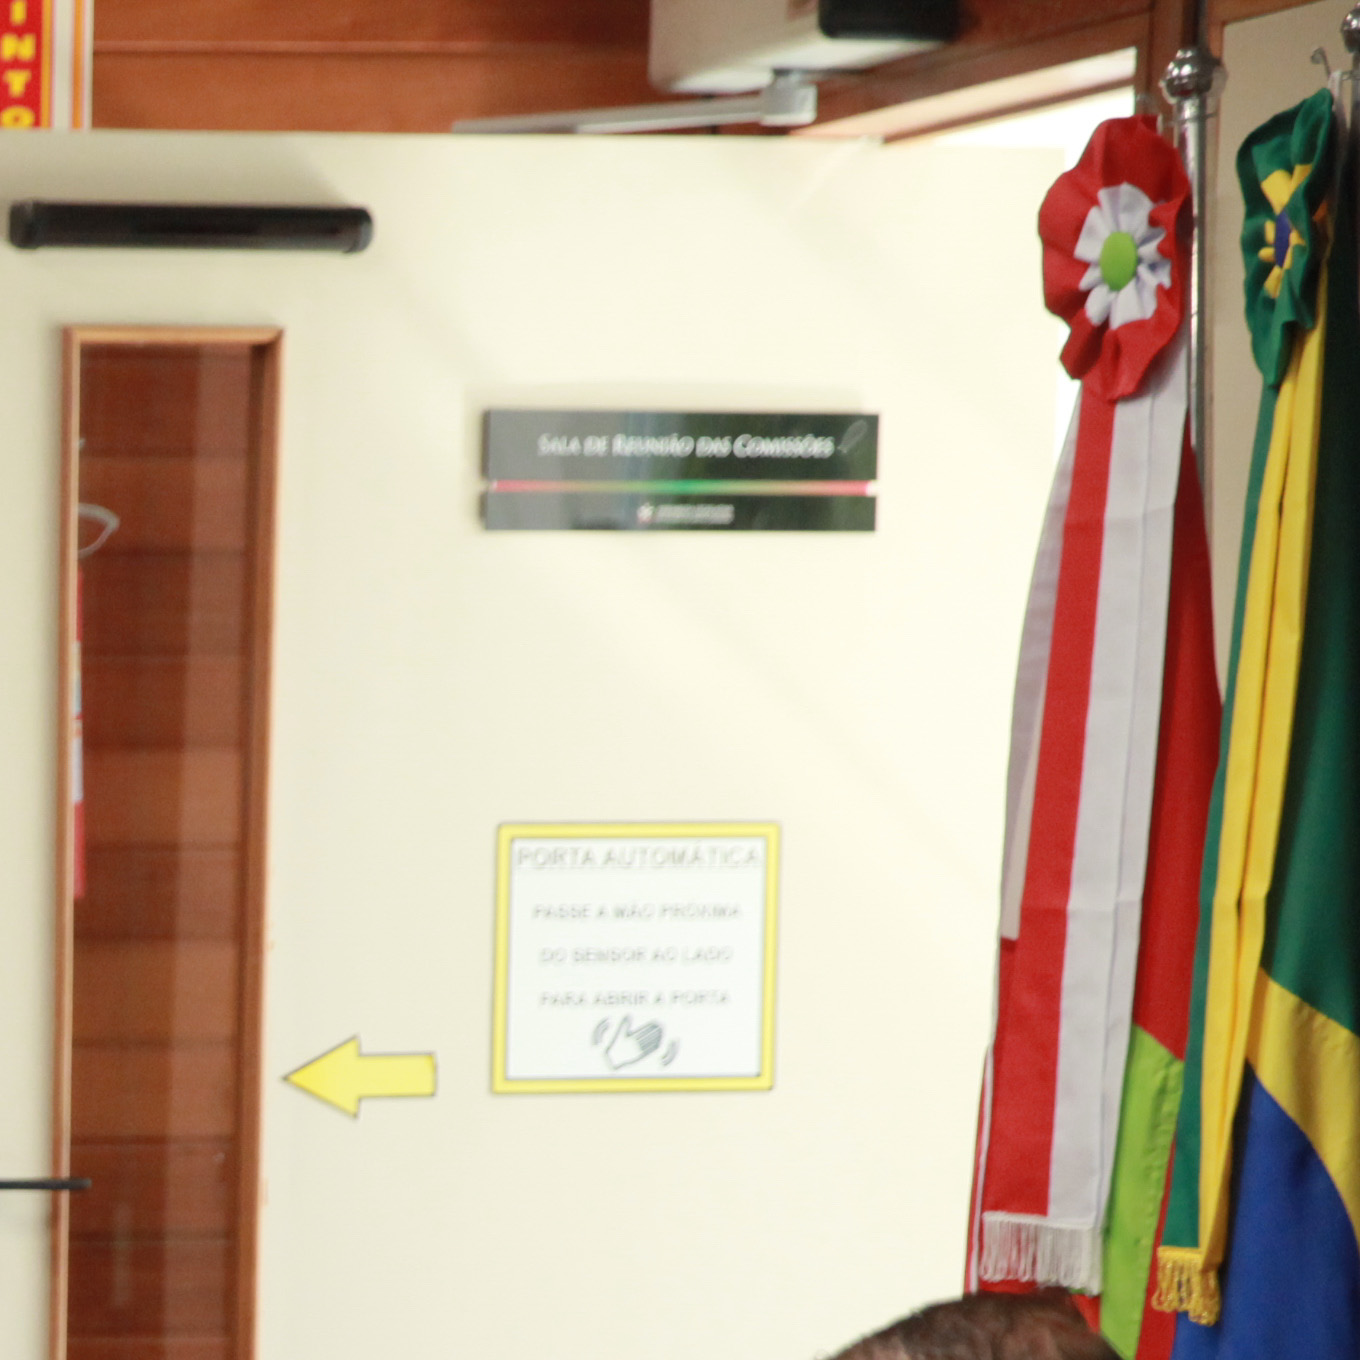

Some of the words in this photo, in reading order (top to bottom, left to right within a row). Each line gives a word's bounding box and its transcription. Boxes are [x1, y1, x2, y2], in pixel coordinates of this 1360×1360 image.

[537, 433, 581, 457] SALA
[583, 435, 609, 457] DE
[612, 433, 694, 457] REUNIÃO
[696, 435, 731, 457] DAS
[733, 433, 835, 458] COMISSÕES
[518, 846, 594, 866] PORTA
[601, 841, 760, 866] AUTOMÁTICA
[533, 903, 592, 918] PASSE
[597, 903, 609, 918] A
[613, 900, 655, 918] MÃO
[540, 946, 568, 962] DO
[573, 946, 646, 962] SENSOR
[652, 946, 678, 962] AO
[683, 945, 732, 961] LADO
[539, 990, 585, 1006] PARA
[593, 990, 648, 1006] ABRIR
[653, 990, 665, 1005] A
[670, 989, 730, 1005] PORTA
